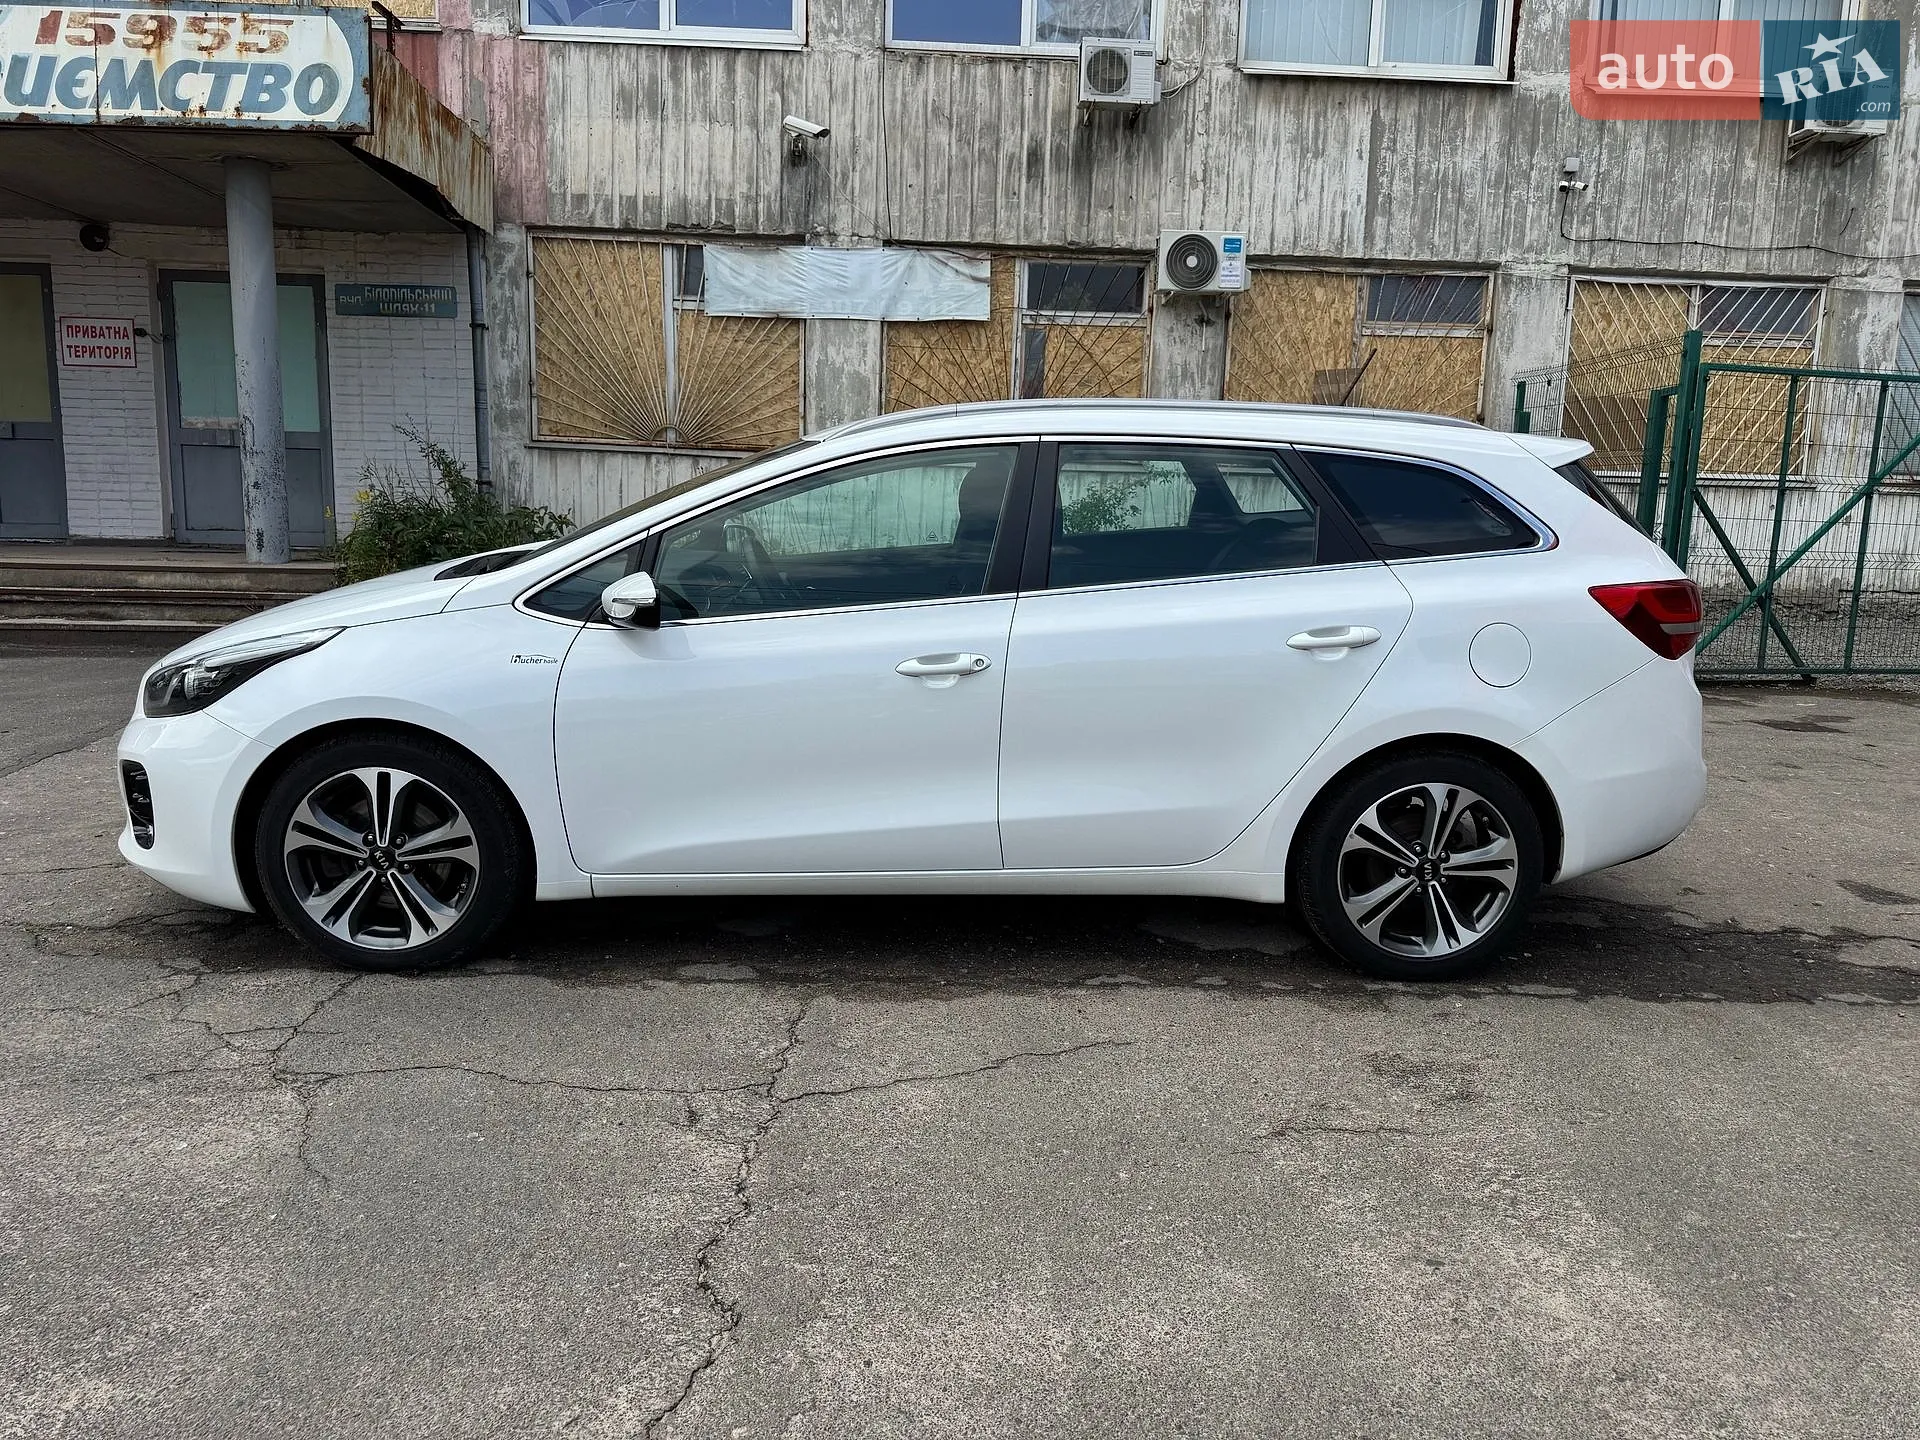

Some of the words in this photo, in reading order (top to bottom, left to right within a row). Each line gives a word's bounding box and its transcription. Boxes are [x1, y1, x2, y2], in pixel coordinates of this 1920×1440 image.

[34, 10, 294, 53] 15955
[0, 53, 340, 116] ИЄМСТВО
[66, 324, 130, 340] ПРИВАТНА
[66, 344, 132, 360] ТЕРИТОРІЯ
[374, 850, 389, 869] KIA
[1424, 861, 1432, 880] KIA
